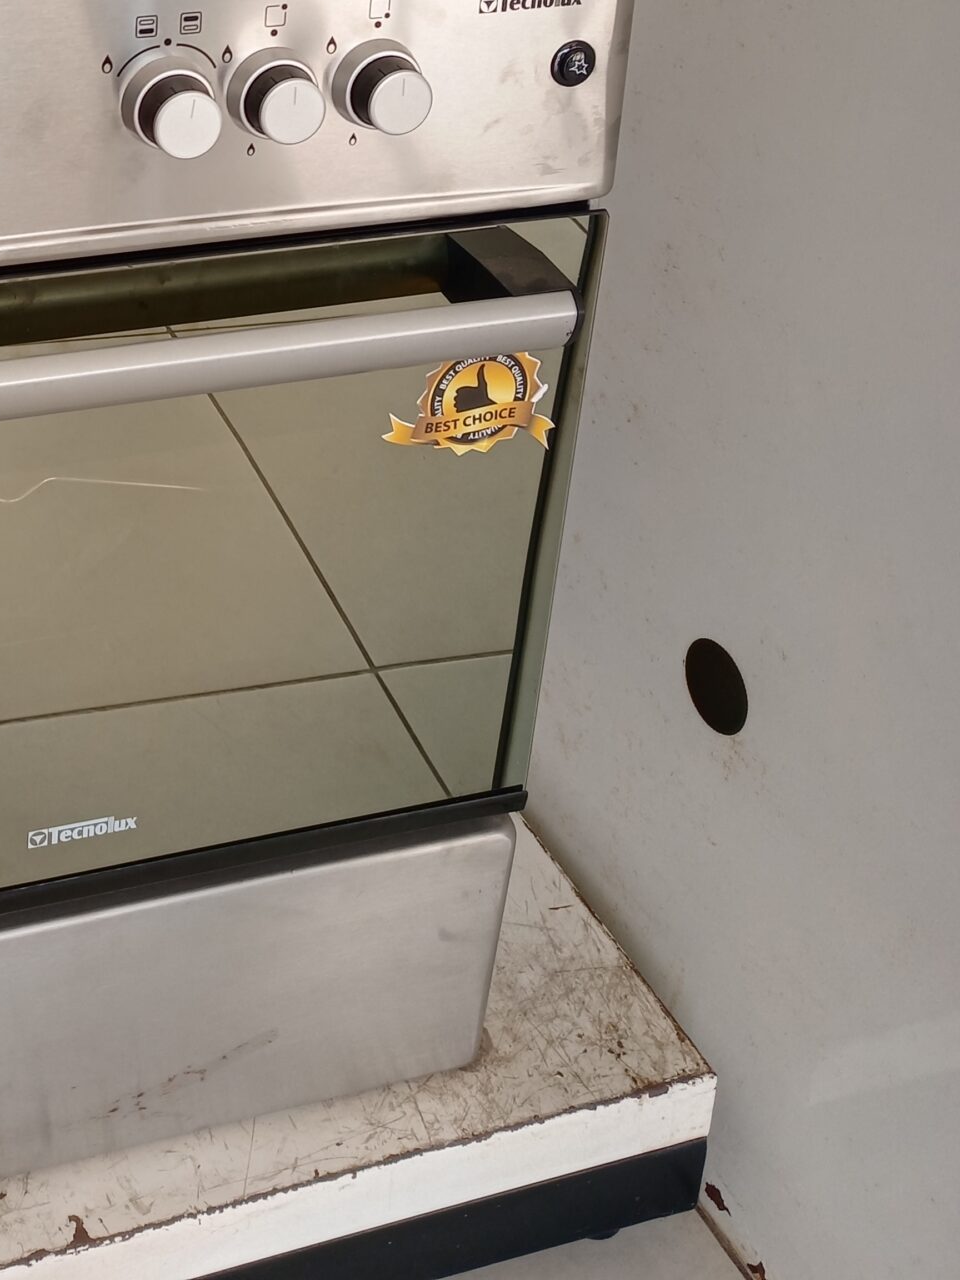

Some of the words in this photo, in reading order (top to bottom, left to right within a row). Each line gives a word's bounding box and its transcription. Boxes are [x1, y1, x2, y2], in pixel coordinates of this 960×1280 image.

[439, 371, 456, 390] BEST
[496, 354, 515, 368] BEST
[511, 365, 524, 399] QUALITY
[424, 418, 460, 434] BEST
[462, 407, 517, 427] CHOICE
[48, 815, 137, 845] Tecnolux
